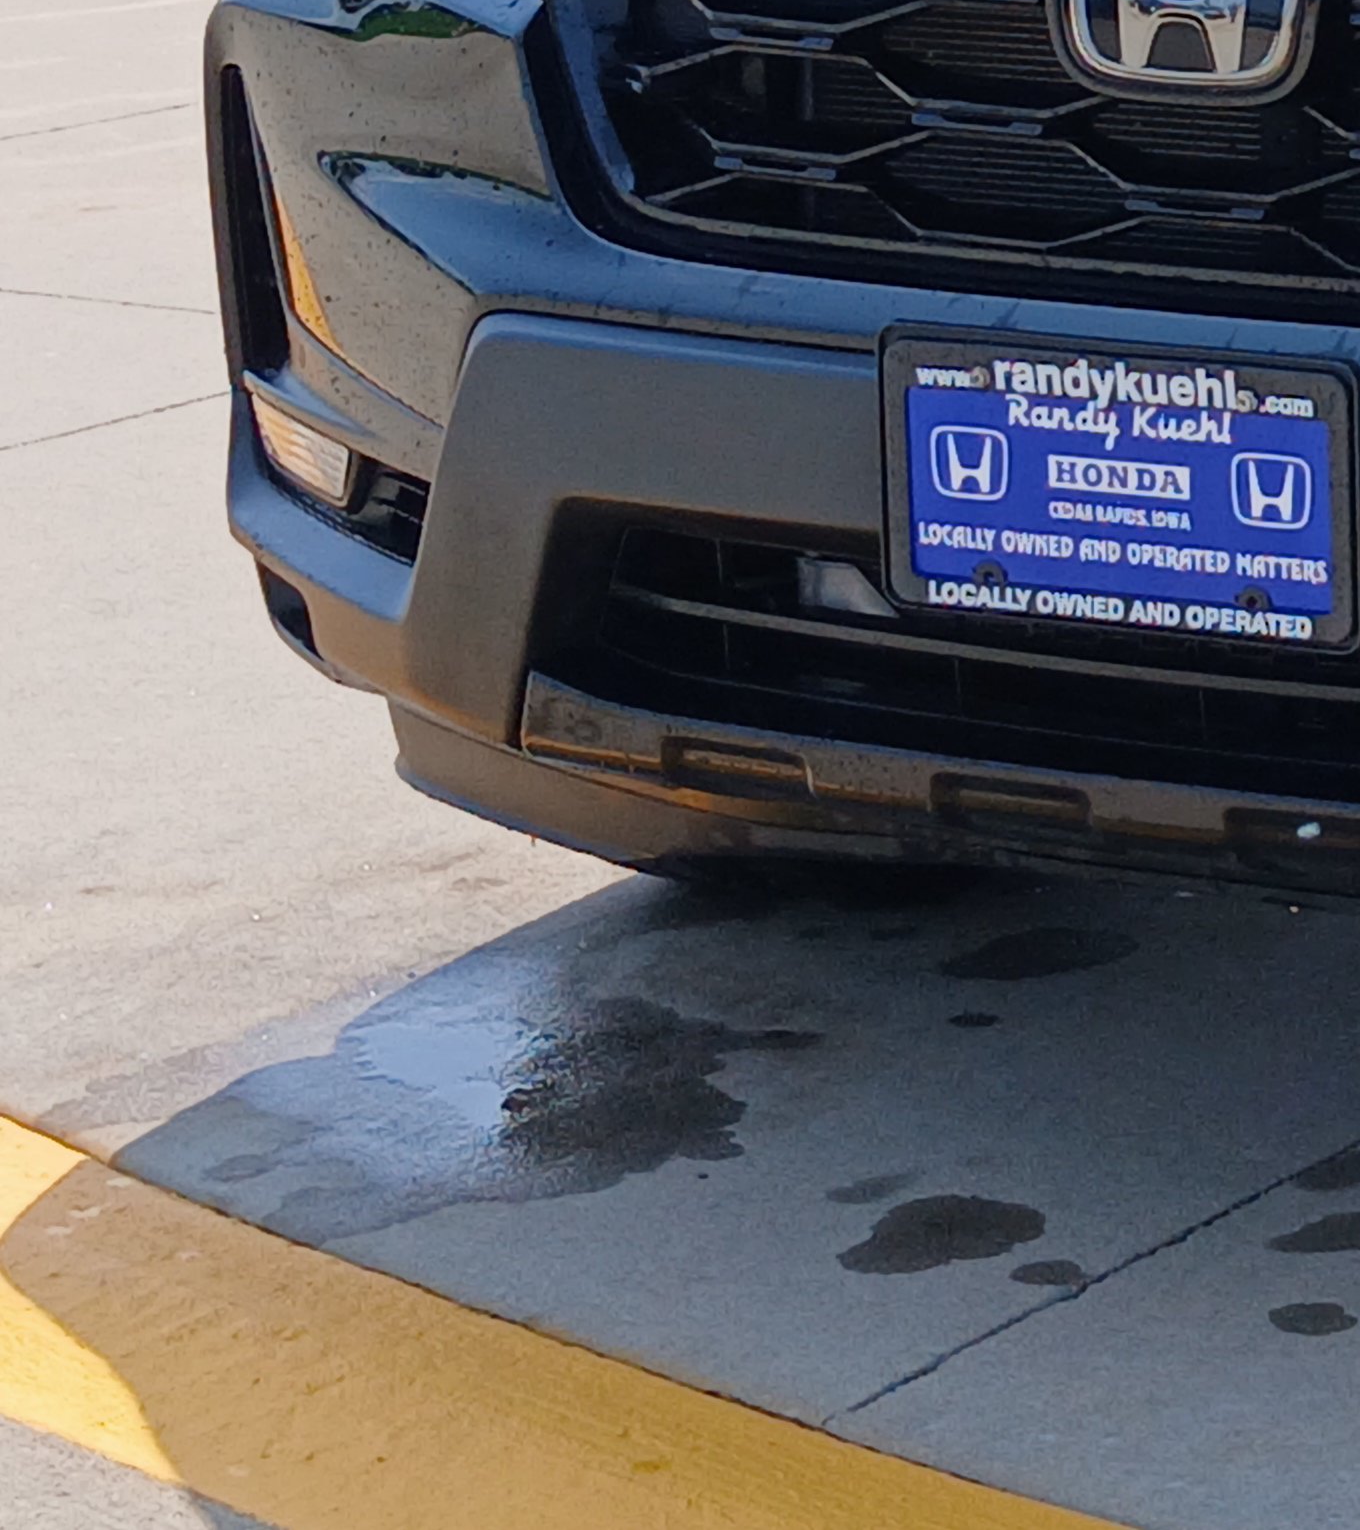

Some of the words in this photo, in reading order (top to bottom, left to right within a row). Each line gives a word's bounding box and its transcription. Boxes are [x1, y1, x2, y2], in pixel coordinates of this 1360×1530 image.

[1005, 393, 1121, 451] Randy
[1132, 406, 1232, 445] Kuehl
[1054, 460, 1184, 495] HONDA
[918, 521, 996, 552] LOCALLY
[1001, 529, 1074, 559] OWNED
[1079, 538, 1121, 564] AND
[1127, 542, 1231, 574] OPERATED
[1236, 552, 1328, 585] MATTERS
[928, 579, 1032, 612] LOCALLY
[1035, 590, 1125, 622] OWNED
[1129, 599, 1181, 627] AND
[1185, 605, 1313, 640] OPERATED
